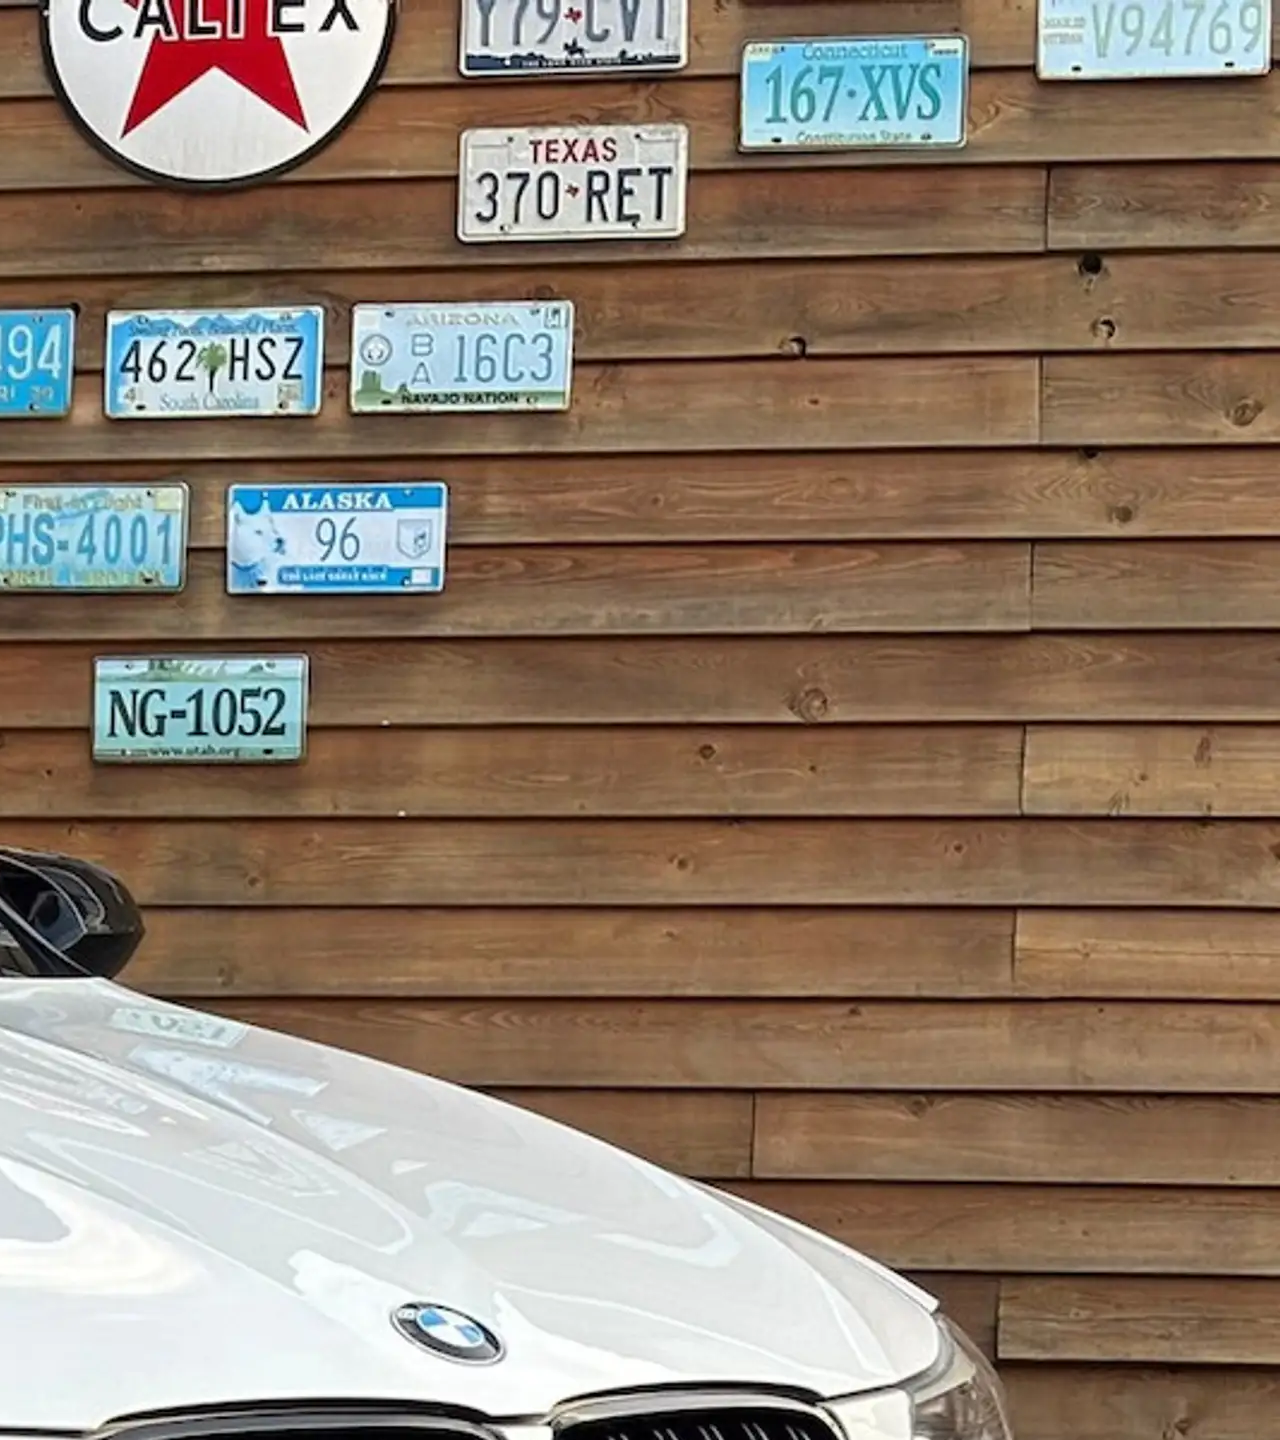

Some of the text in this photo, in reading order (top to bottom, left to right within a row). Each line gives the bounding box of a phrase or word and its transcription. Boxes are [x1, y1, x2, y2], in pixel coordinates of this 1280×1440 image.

[1092, 0, 1263, 58] V94769
[530, 137, 618, 164] TEXAS
[476, 167, 674, 224] 370 RET
[406, 311, 520, 327] ARIZONA
[120, 337, 305, 383] 462 HSZ
[454, 333, 554, 384] 16C3
[401, 390, 519, 405] NAVAJO NATION
[281, 491, 394, 511] ALASKA
[315, 517, 361, 562] 96
[107, 687, 287, 738] NG-1052
